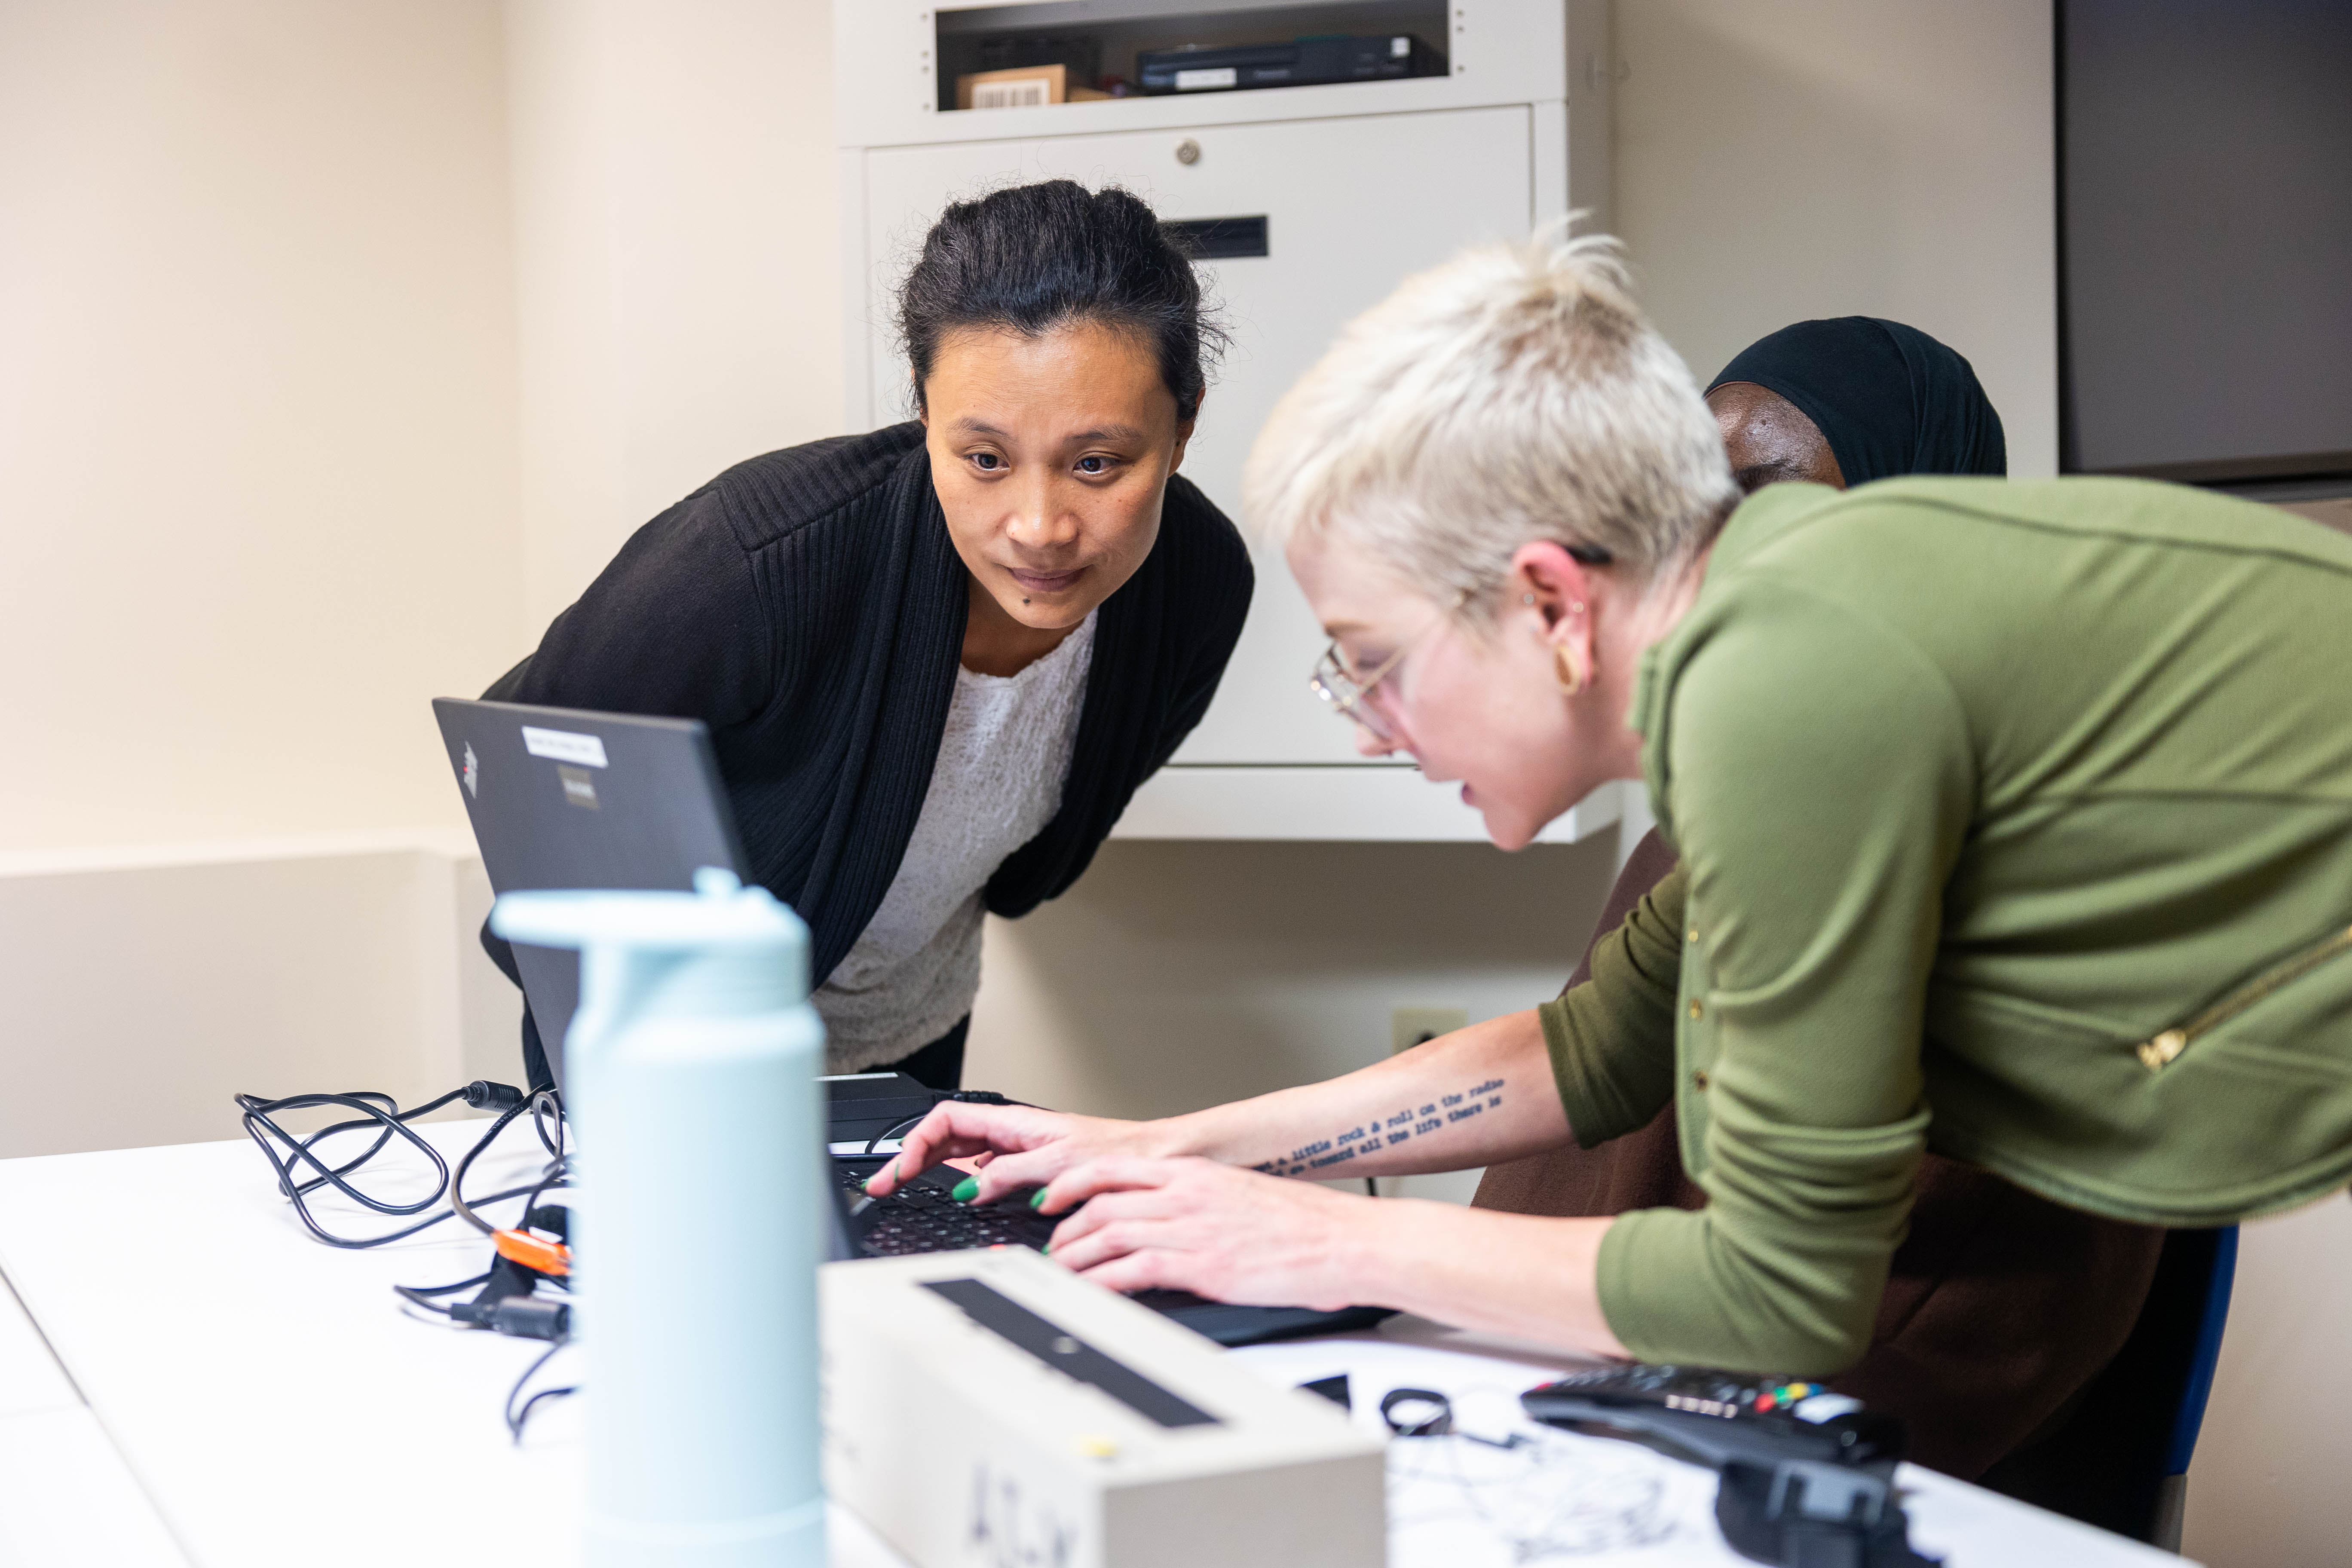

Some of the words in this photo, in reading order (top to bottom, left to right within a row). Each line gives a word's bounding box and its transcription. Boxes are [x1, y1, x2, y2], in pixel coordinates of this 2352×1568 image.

[1292, 1141, 1331, 1161] little
[1338, 1127, 1365, 1145] rock
[1371, 1121, 1381, 1133] &
[1387, 1109, 1413, 1128] roll
[1420, 1104, 1436, 1116] on
[1442, 1094, 1463, 1108] the
[1470, 1079, 1504, 1097] radio
[1360, 1138, 1383, 1154] all
[1387, 1130, 1409, 1145] the
[1415, 1118, 1442, 1135] life
[1447, 1104, 1482, 1122] there
[1488, 1096, 1502, 1108] is
